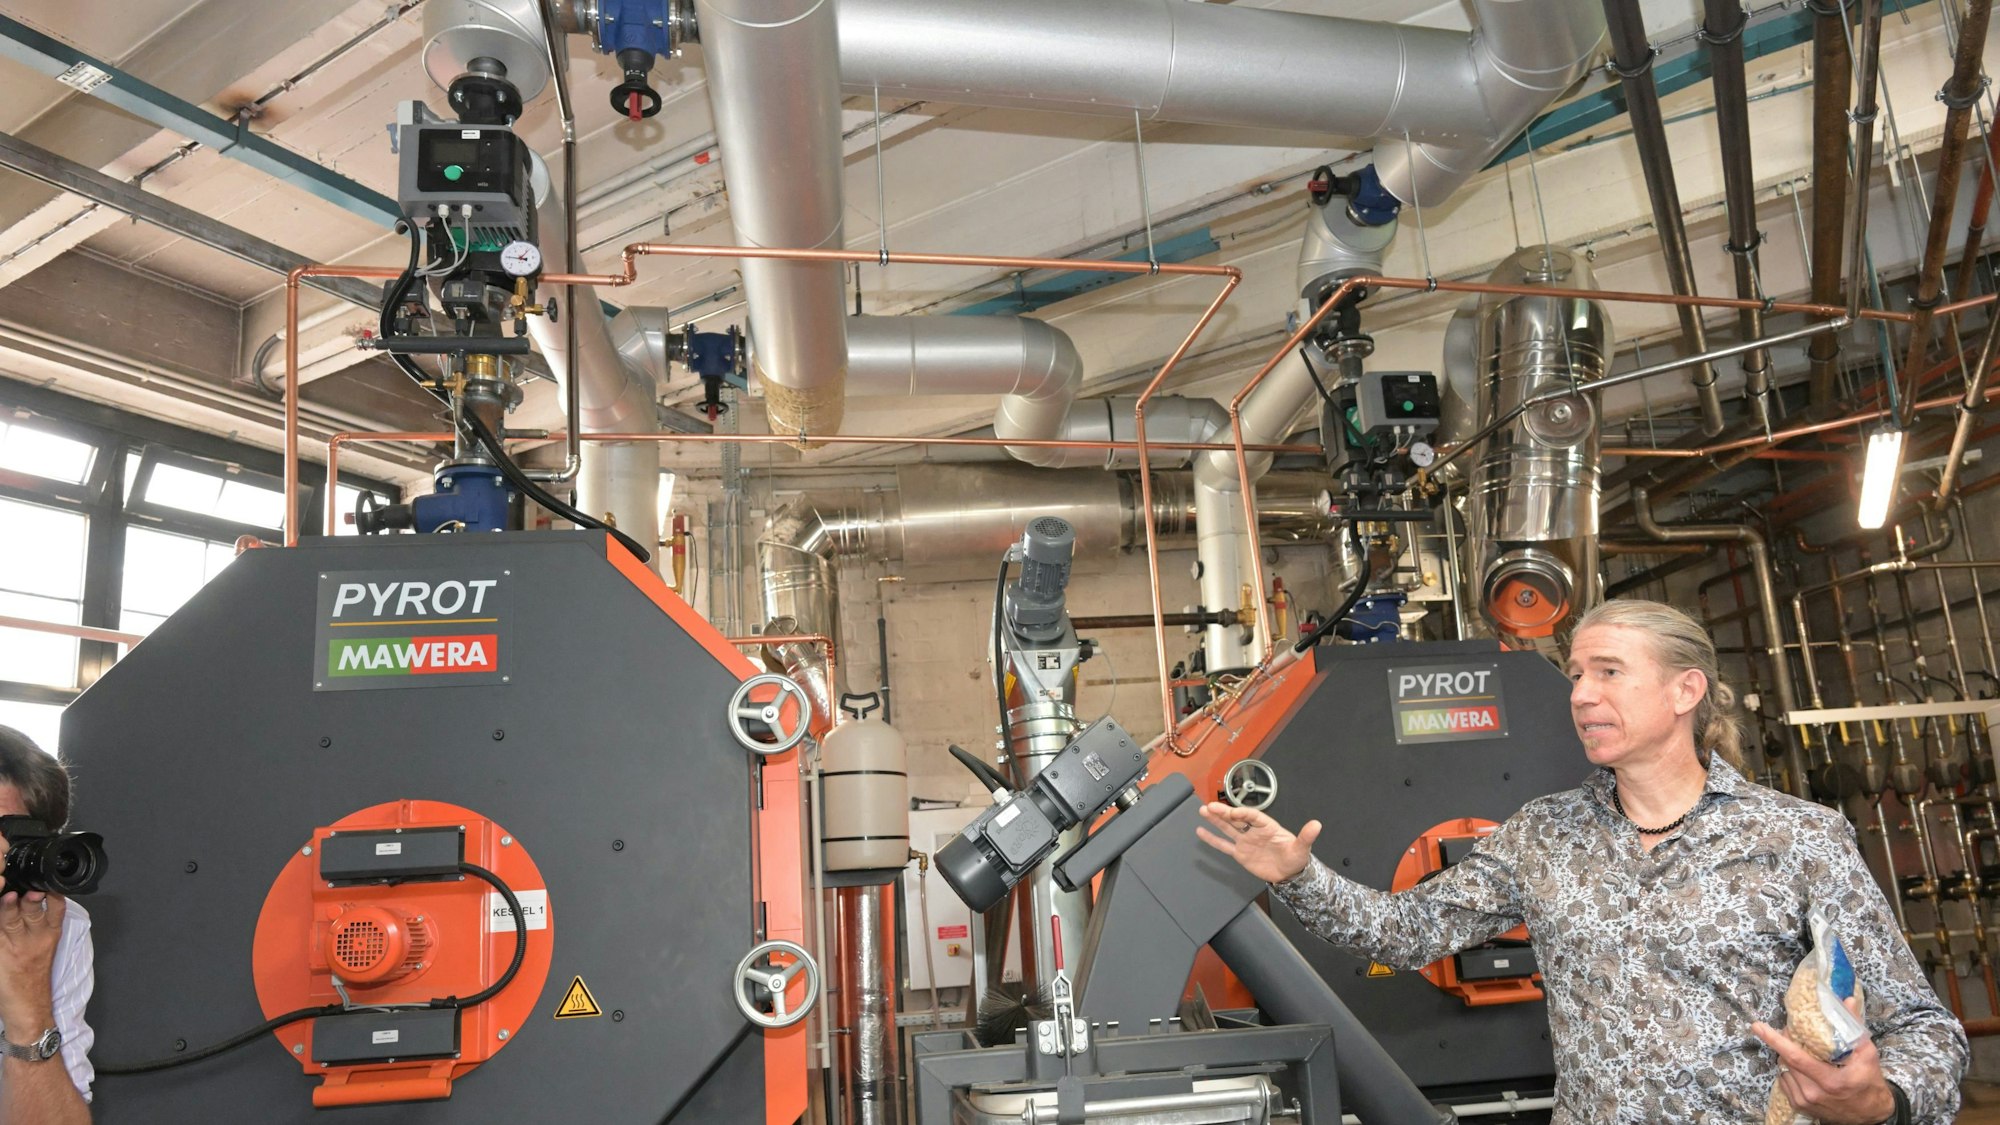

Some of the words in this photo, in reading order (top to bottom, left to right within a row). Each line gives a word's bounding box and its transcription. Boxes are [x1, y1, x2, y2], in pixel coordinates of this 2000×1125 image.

[332, 579, 498, 617] PYROT
[337, 641, 488, 671] MAWERA
[1399, 671, 1491, 697] PYROT
[1408, 710, 1494, 731] MAWERA
[493, 906, 535, 917] KESEL
[539, 905, 543, 914] 1
